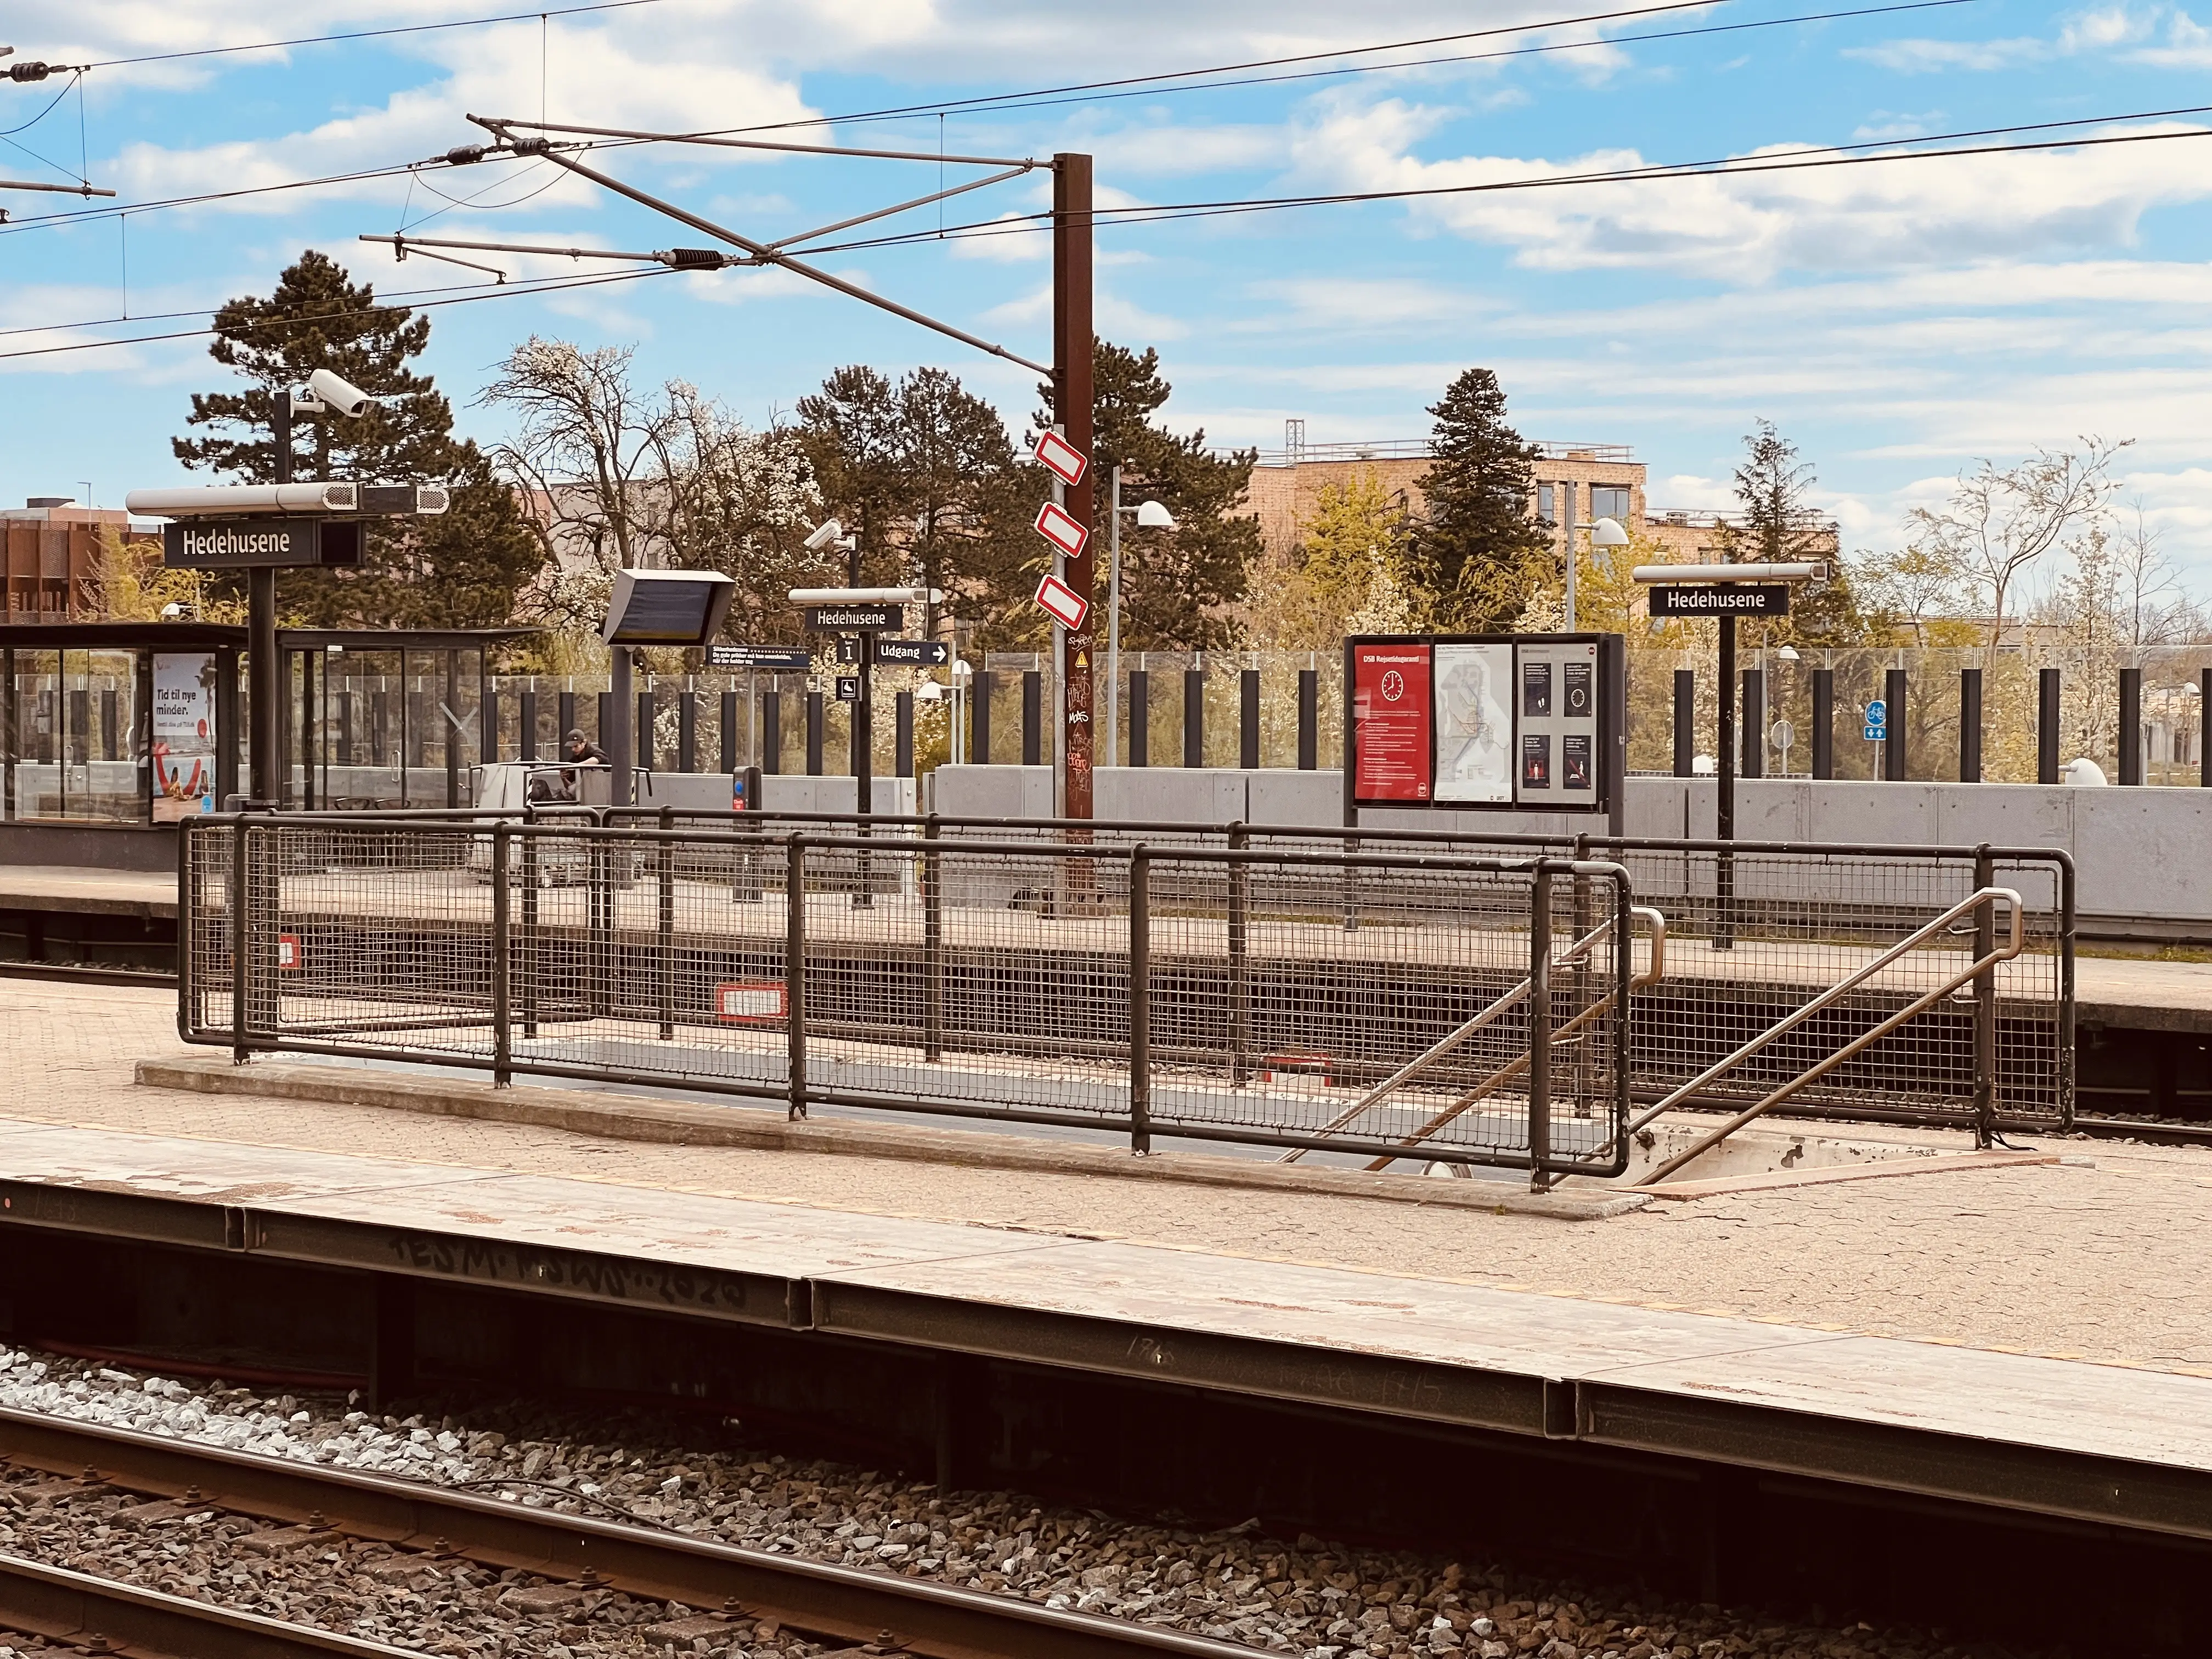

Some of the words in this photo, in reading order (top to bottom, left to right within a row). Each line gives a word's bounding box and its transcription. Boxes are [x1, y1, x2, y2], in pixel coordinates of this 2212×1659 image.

[183, 528, 290, 555] Hedehusene
[1668, 590, 1765, 608] Hedehusene
[817, 610, 885, 624] Hedehusene
[845, 646, 853, 660] 1
[881, 645, 920, 659] Udgang
[157, 689, 169, 700] Tid
[171, 690, 180, 700] til
[182, 692, 196, 703] nye
[156, 703, 188, 715] minder.
